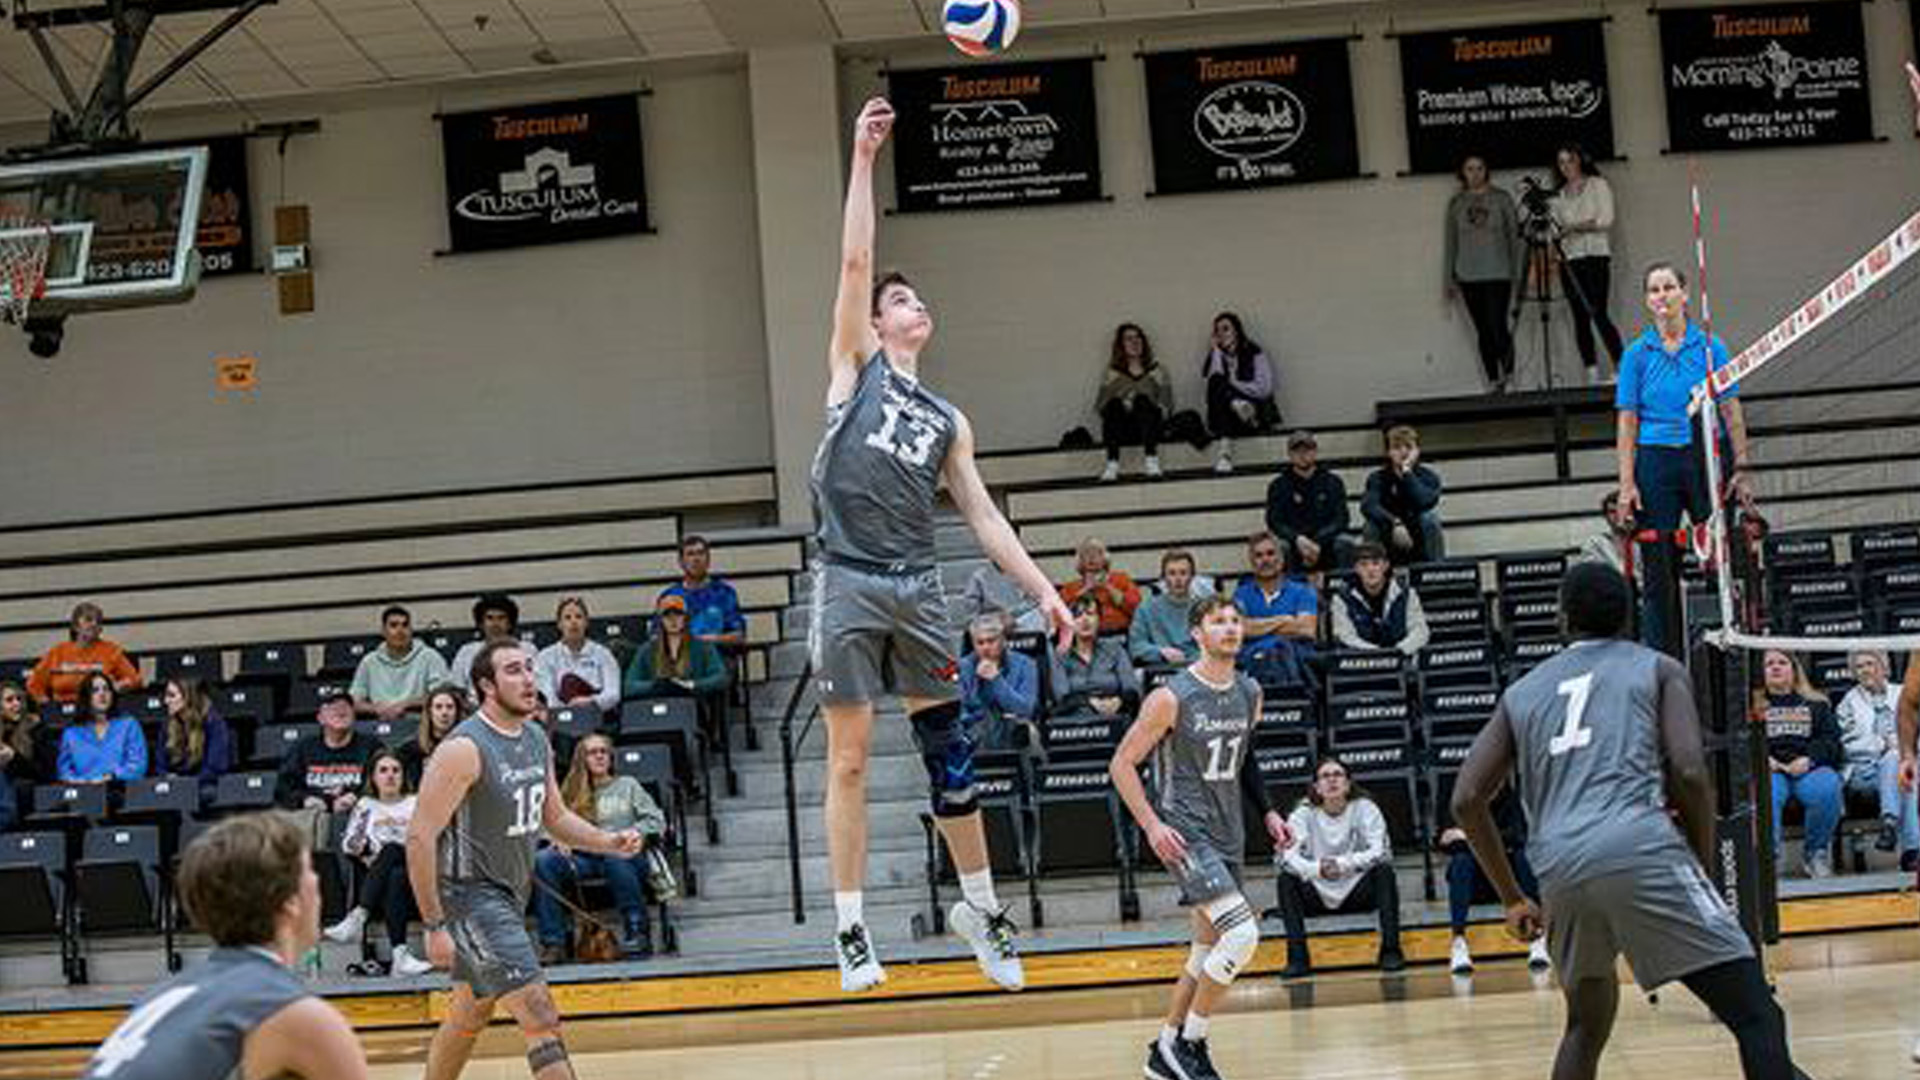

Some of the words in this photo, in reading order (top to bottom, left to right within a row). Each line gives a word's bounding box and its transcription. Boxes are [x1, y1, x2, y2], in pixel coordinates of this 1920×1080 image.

[1792, 57, 1860, 79] Pointe
[1418, 86, 1489, 110] Premium
[931, 121, 1050, 142] Hometown
[473, 186, 598, 214] TUSCULUM
[865, 402, 939, 466] 13
[1549, 671, 1594, 756] 1
[1202, 736, 1241, 780] 11
[507, 784, 546, 837] 18
